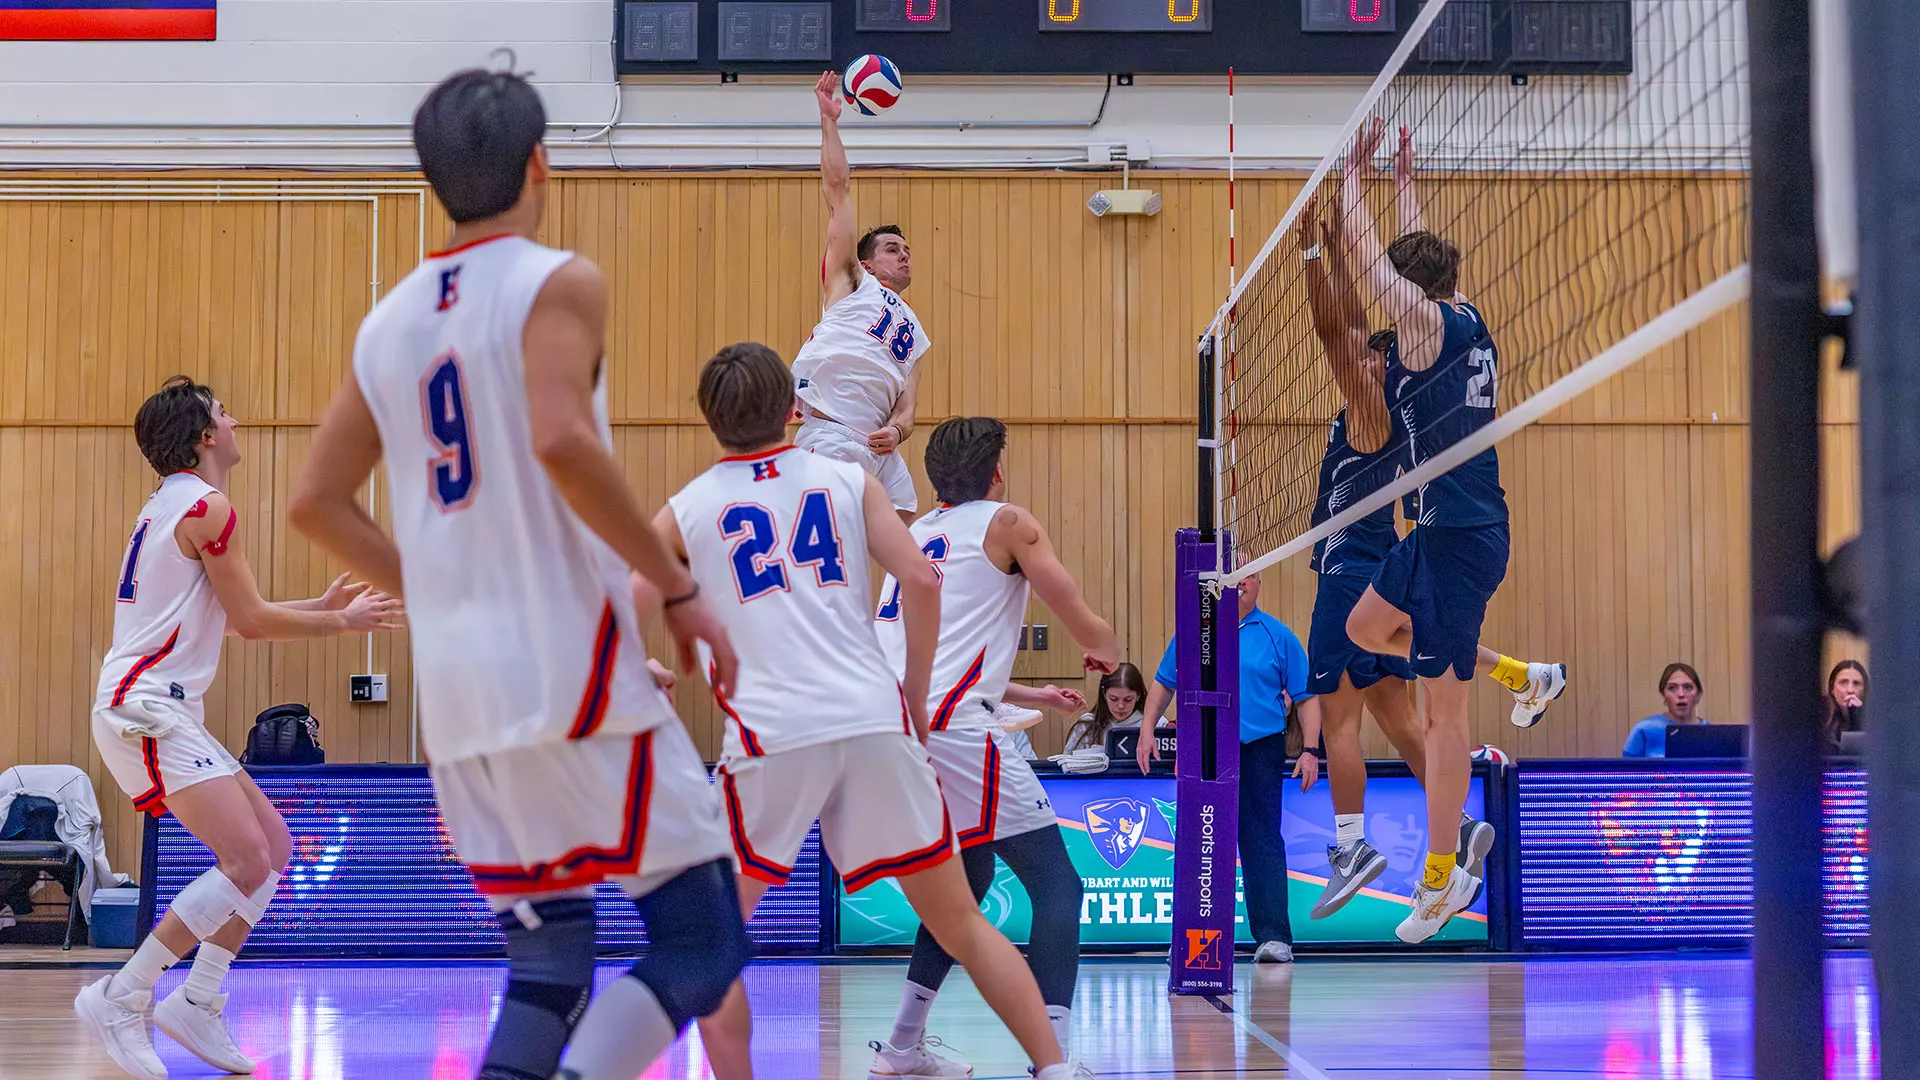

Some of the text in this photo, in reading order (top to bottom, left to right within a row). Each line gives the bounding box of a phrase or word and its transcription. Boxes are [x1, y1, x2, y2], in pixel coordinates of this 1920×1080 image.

[866, 305, 915, 364] 18
[1465, 346, 1498, 408] 21
[419, 346, 482, 514] 9
[750, 459, 780, 482] H
[117, 518, 151, 604] 1
[717, 488, 848, 605] 24
[1122, 878, 1147, 888] AND
[1198, 805, 1214, 917] sports imports
[1185, 929, 1222, 970] H
